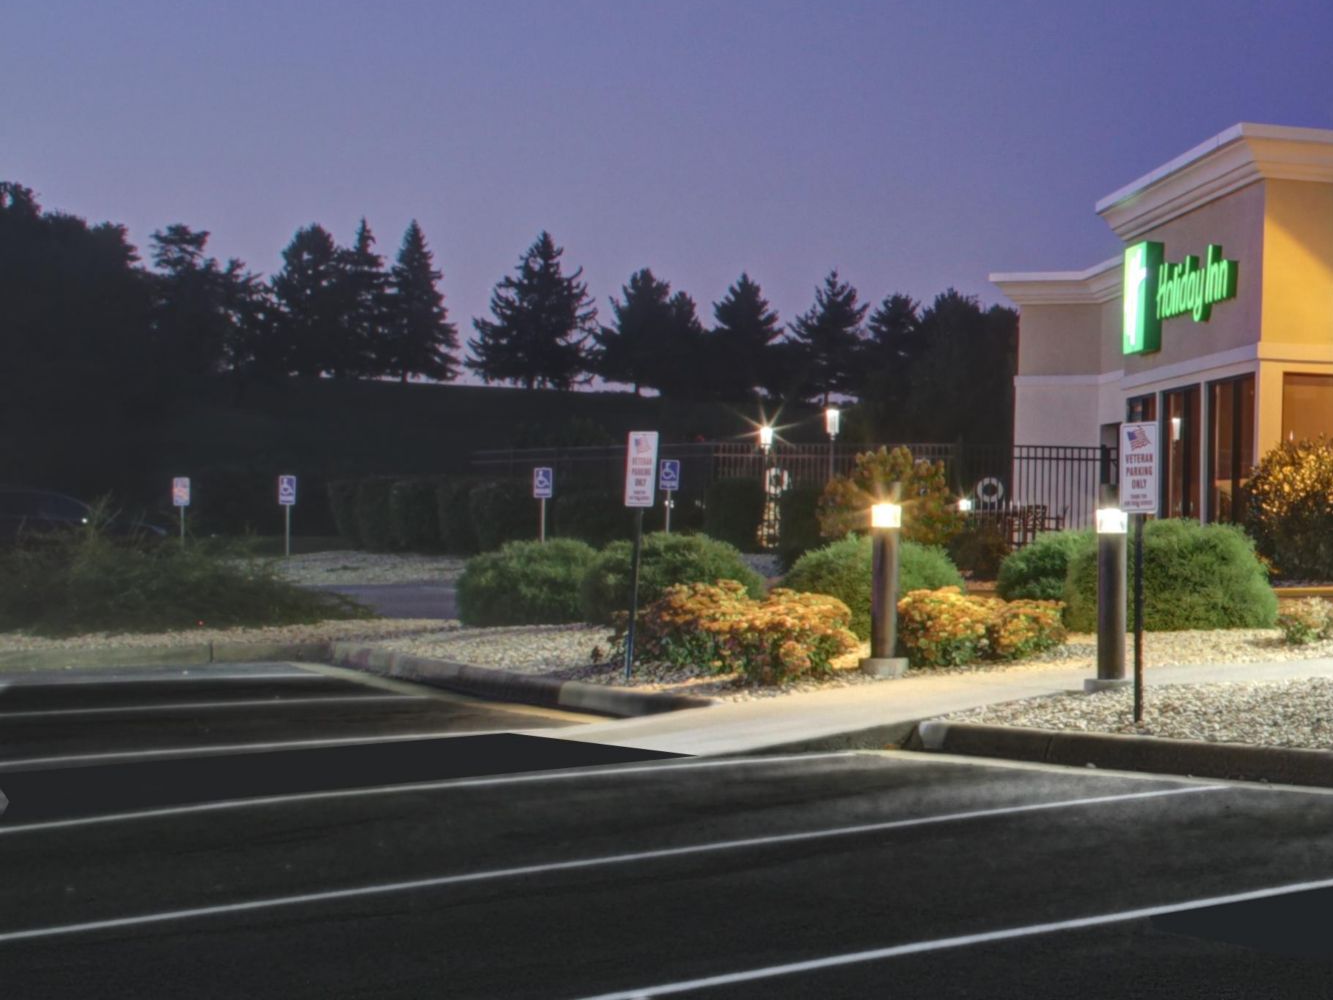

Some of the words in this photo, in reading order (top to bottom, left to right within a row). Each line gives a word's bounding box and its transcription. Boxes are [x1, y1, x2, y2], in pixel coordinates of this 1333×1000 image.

[1156, 254, 1206, 322] Holiday
[1204, 243, 1229, 304] Inn
[1125, 453, 1153, 464] VETERAN
[1126, 466, 1153, 477] PARKING
[1131, 478, 1147, 489] ONLY
